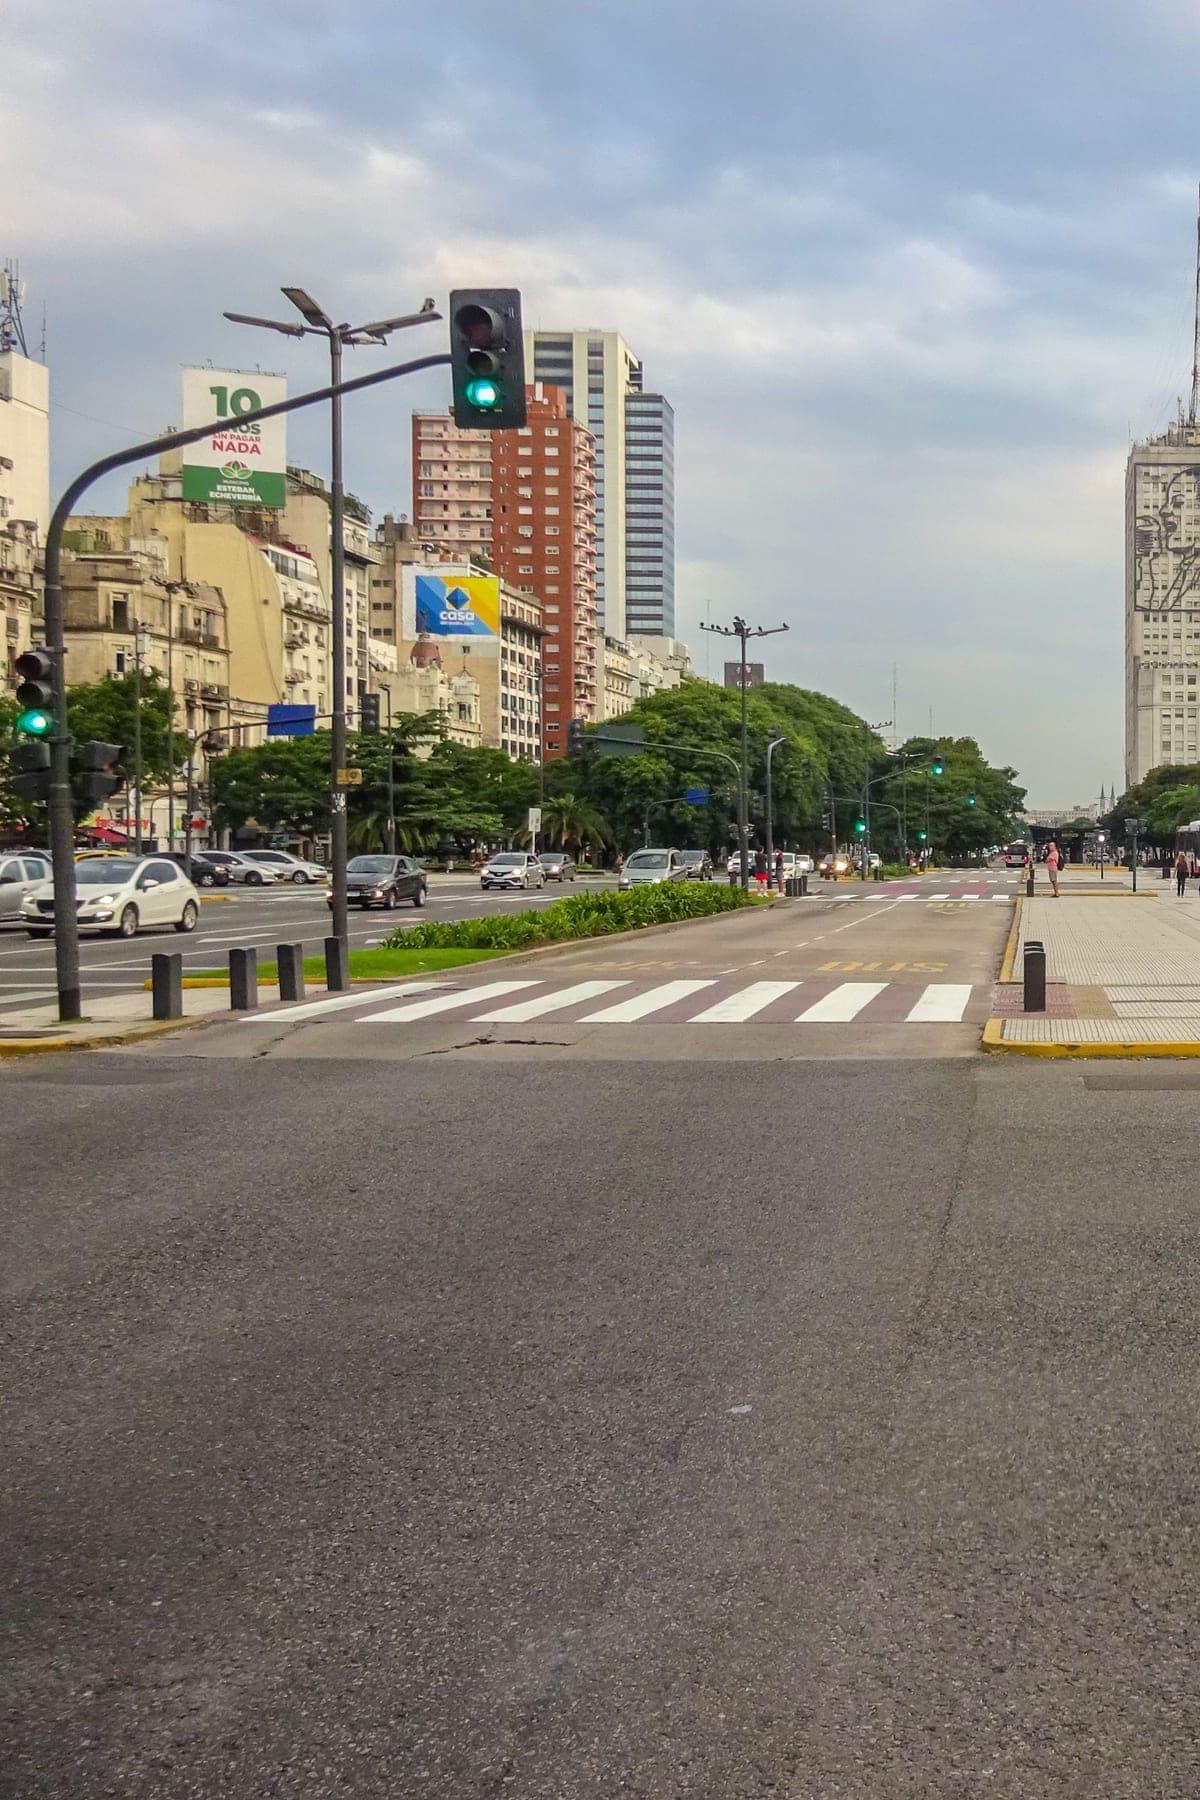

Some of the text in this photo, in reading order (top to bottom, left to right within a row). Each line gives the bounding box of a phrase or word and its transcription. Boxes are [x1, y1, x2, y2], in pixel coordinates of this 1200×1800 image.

[209, 386, 261, 417] 10
[230, 433, 261, 443] PAGAR
[212, 440, 261, 455] NADA
[216, 484, 255, 496] ESTEBAN
[440, 611, 475, 621] casa
[816, 961, 948, 972] BUS
